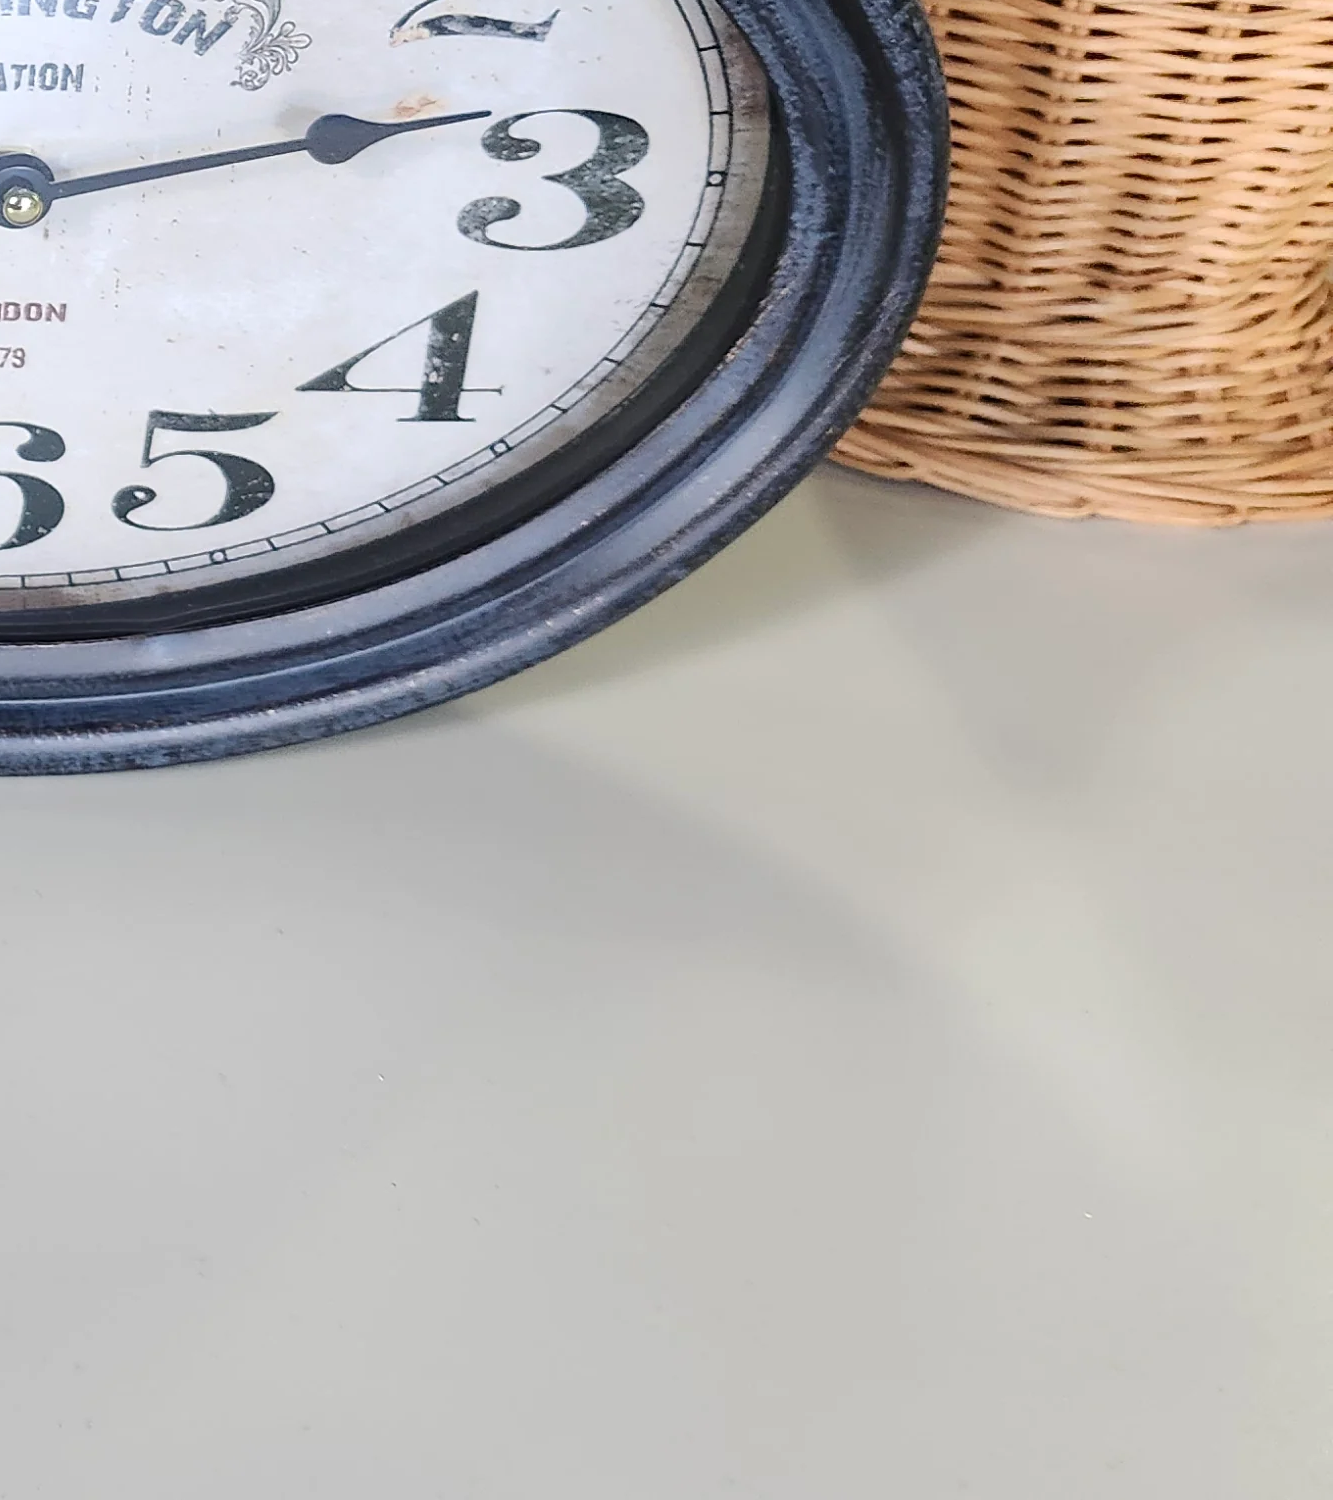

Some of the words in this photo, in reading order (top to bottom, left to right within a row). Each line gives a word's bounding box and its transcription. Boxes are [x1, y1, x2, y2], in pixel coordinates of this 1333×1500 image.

[457, 109, 651, 250] 3
[296, 290, 503, 423] 4
[112, 410, 280, 533] 5
